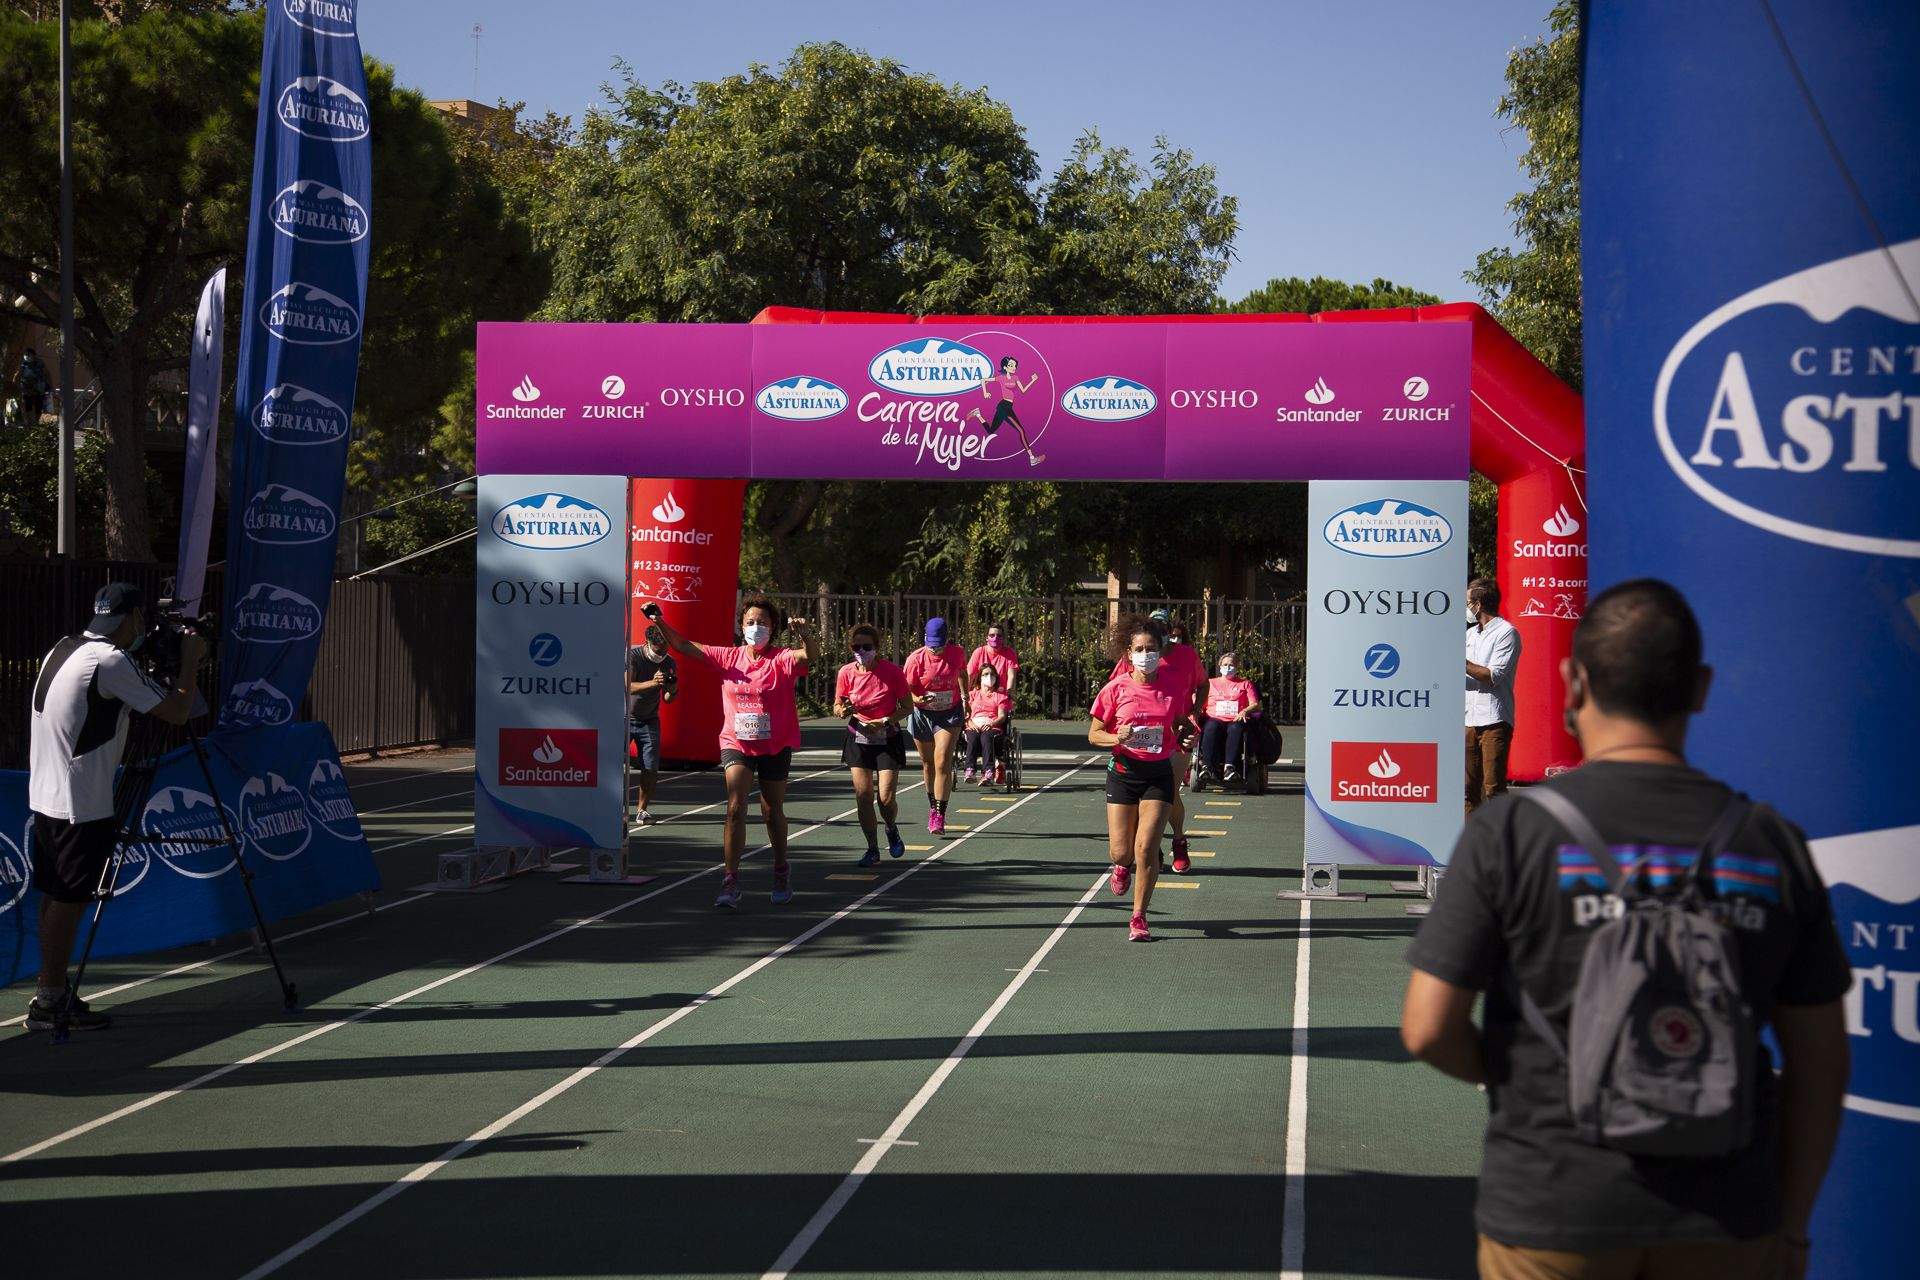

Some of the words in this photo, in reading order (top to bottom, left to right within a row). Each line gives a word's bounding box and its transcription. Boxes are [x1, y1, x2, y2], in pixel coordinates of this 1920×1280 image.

[277, 199, 360, 235] ASURIANA
[270, 302, 350, 335] ASURIANA
[879, 359, 982, 381] ASTURIANA
[661, 388, 744, 406] OYSHO
[763, 393, 842, 409] ASTURIANA
[1069, 393, 1149, 410] ASTURIANA
[1171, 390, 1258, 408] OYSHO
[486, 404, 566, 419] Santander
[582, 405, 645, 419] ZURICH
[857, 392, 960, 423] Carrera
[1277, 407, 1362, 422] Santander
[1382, 408, 1450, 421] ZURICH
[260, 404, 339, 435] ASRIANA
[882, 424, 900, 445] de
[904, 424, 919, 446] la
[915, 420, 998, 471] Mujer
[500, 513, 602, 535] ASTURIANA
[1333, 520, 1443, 543] ASTURIANA
[492, 580, 610, 606] OYSHO
[1324, 589, 1450, 615] OYSHO
[501, 676, 591, 695] ZURICH
[1333, 689, 1431, 708] ZURICH
[505, 766, 591, 782] Santander
[1338, 780, 1430, 797] Santander
[319, 798, 356, 822] ASTURI
[1572, 894, 1767, 931] pania
